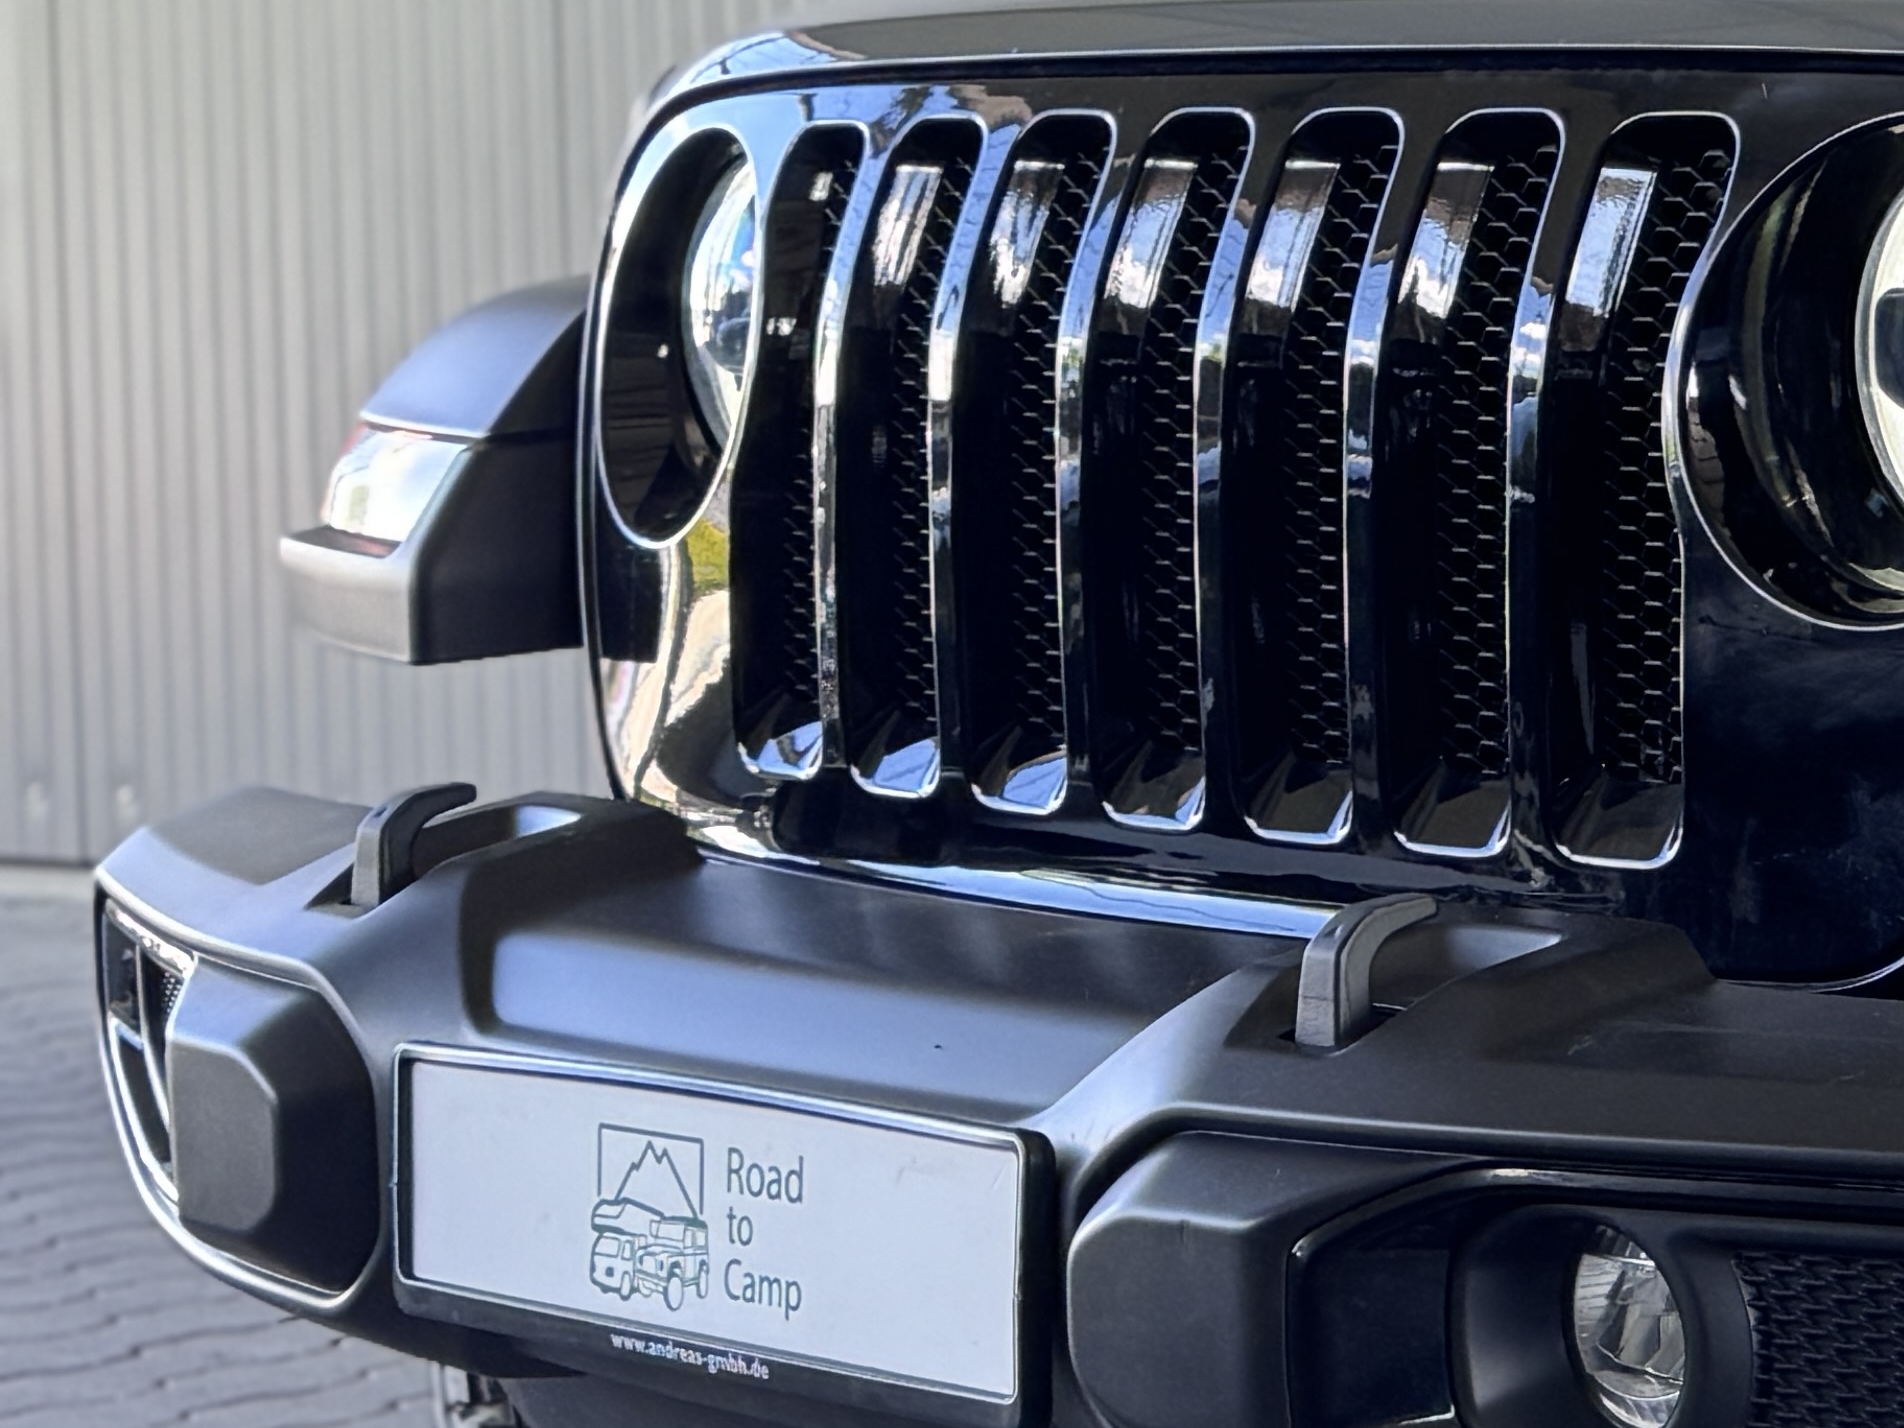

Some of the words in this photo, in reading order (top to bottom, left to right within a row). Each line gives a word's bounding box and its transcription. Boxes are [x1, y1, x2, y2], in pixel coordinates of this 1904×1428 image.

[727, 1147, 805, 1205] Road
[727, 1207, 754, 1247] to
[724, 1258, 803, 1322] Camp
[610, 1333, 770, 1380] www.andreas-gmbh.de
